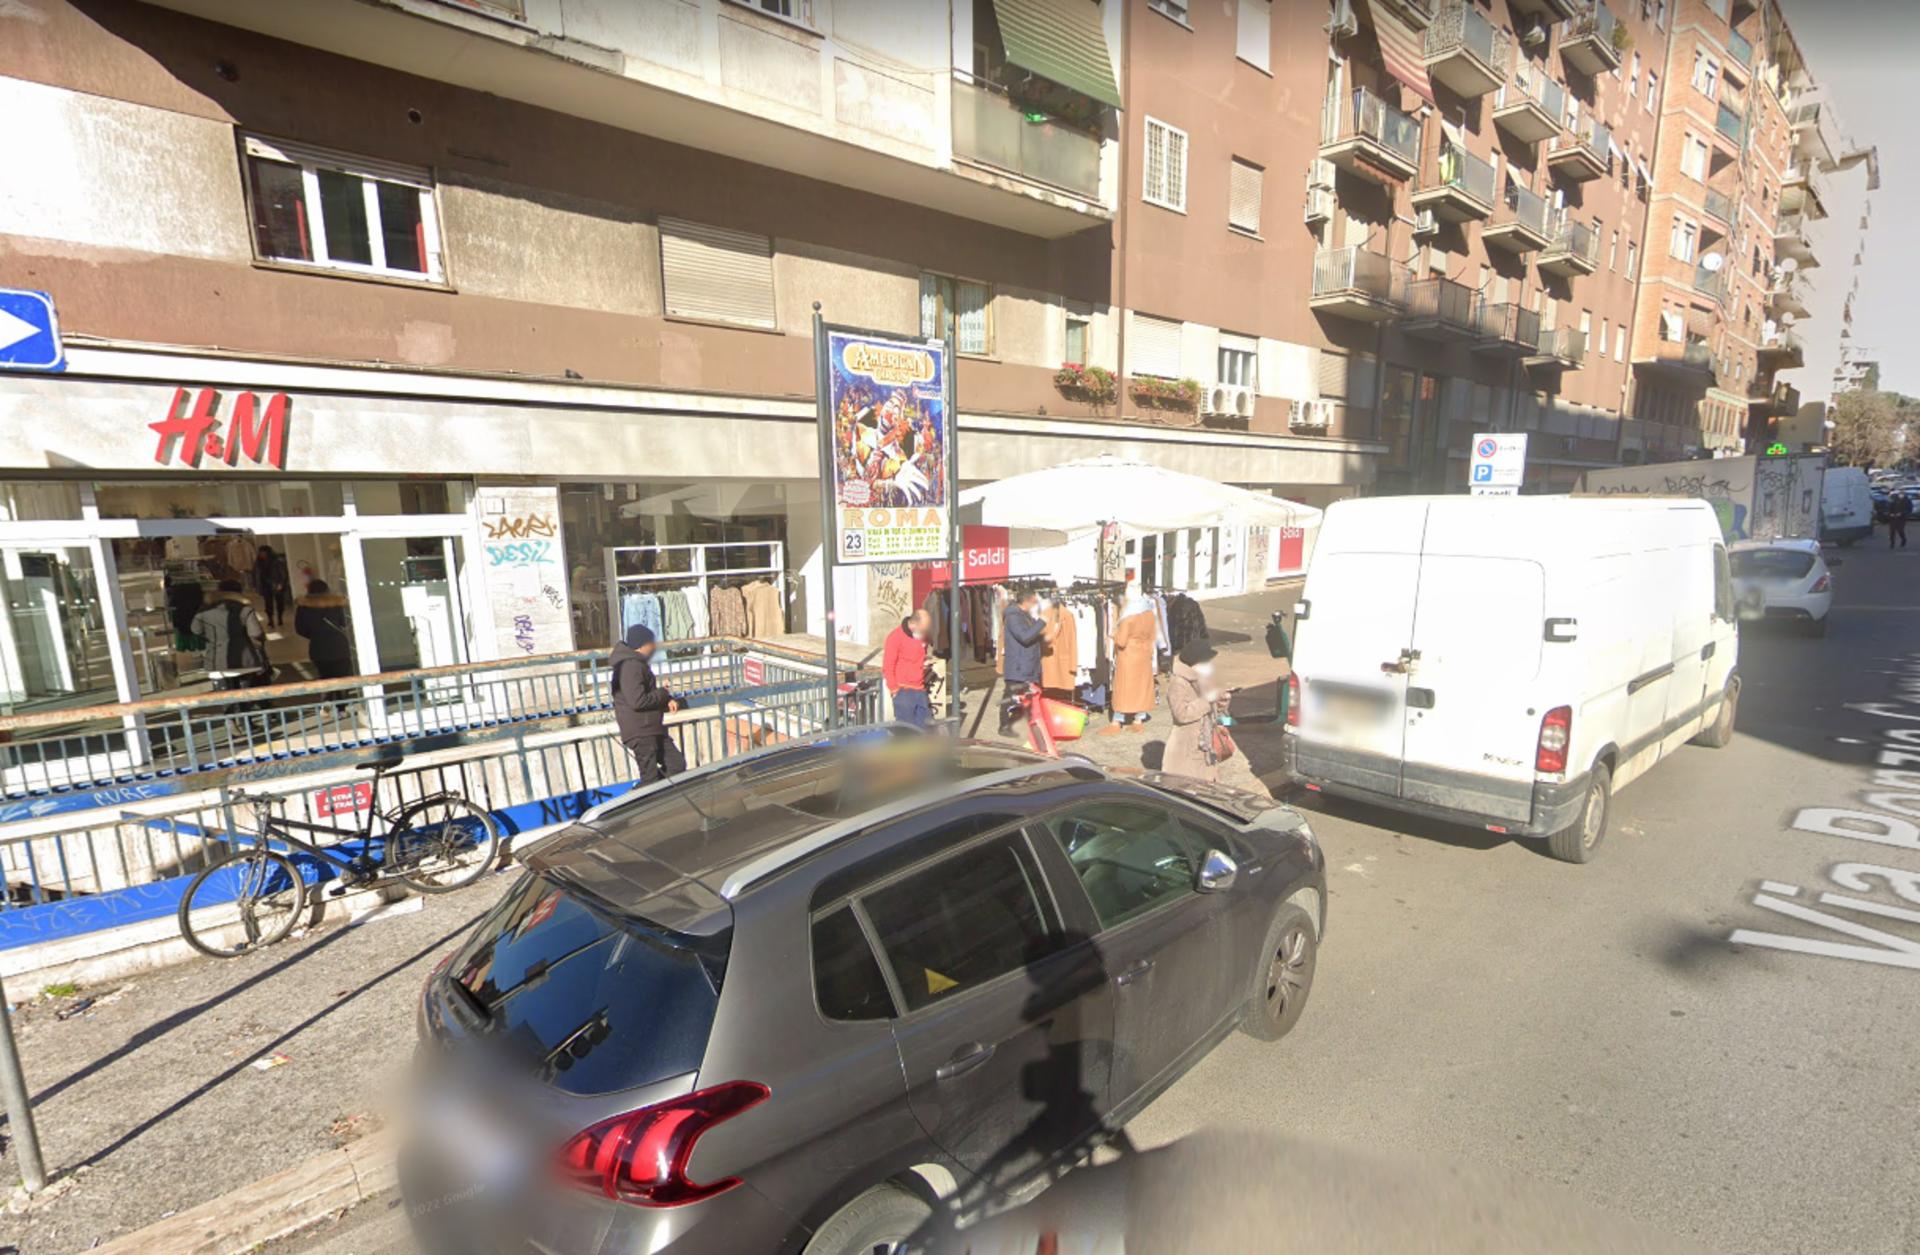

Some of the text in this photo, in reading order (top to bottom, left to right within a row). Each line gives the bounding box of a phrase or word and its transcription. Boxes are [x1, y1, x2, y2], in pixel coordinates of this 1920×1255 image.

[852, 344, 930, 380] AMERICAN
[148, 386, 291, 470] H&M
[843, 508, 942, 528] ROMA
[846, 534, 862, 549] 23
[968, 546, 1005, 567] Saldi
[1729, 862, 1920, 969] Via
